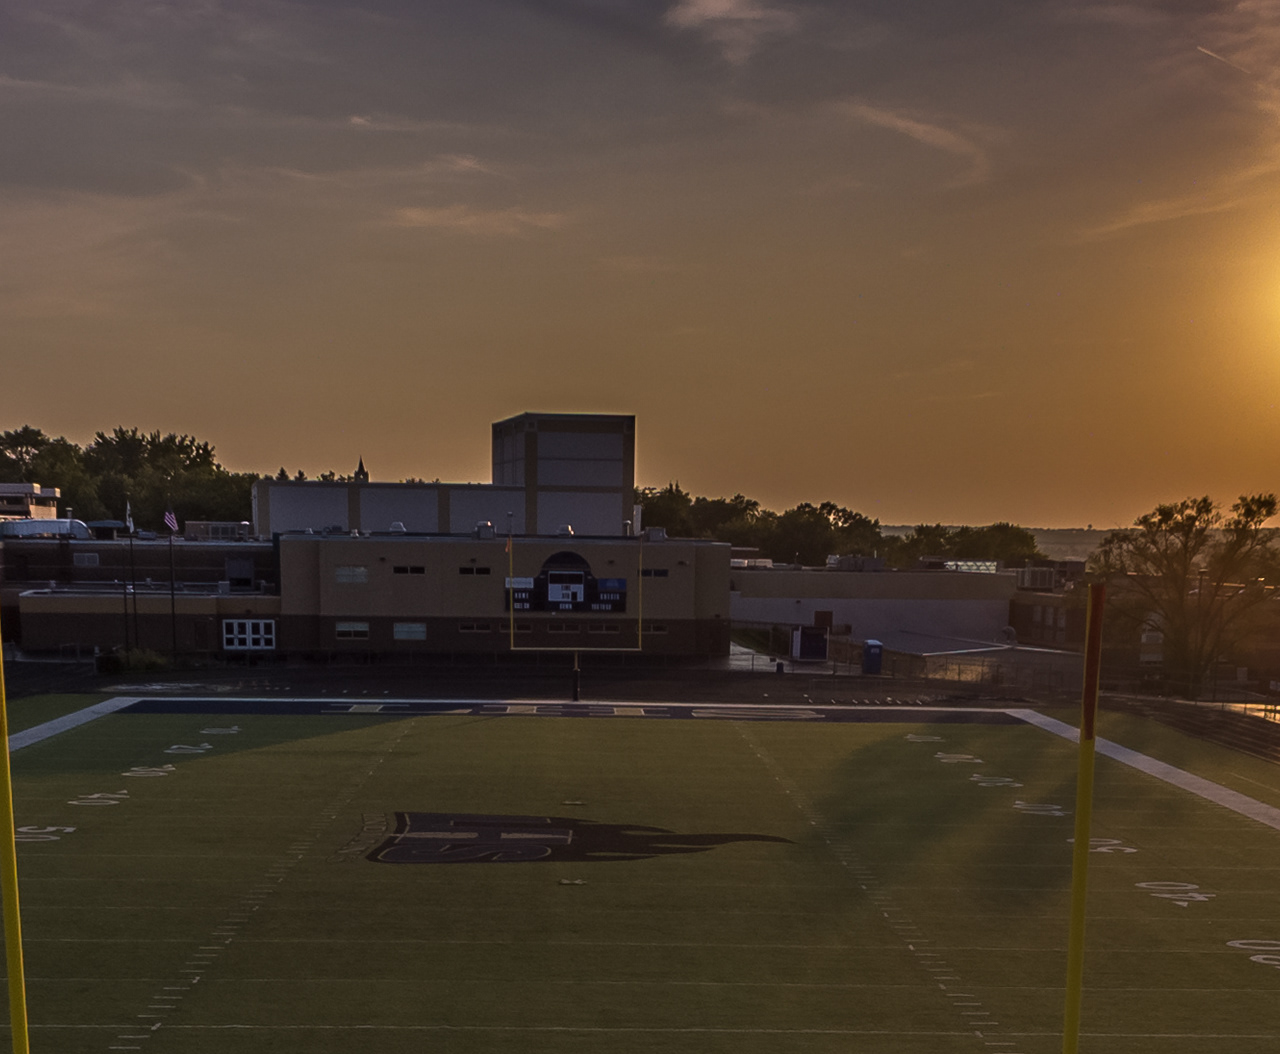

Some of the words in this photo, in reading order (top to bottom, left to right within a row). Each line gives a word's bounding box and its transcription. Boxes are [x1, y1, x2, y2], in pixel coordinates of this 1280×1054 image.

[120, 766, 176, 777] 30
[66, 793, 130, 806] 40
[1012, 803, 1073, 817] 40
[14, 826, 77, 842] 50
[1134, 881, 1216, 901] 40
